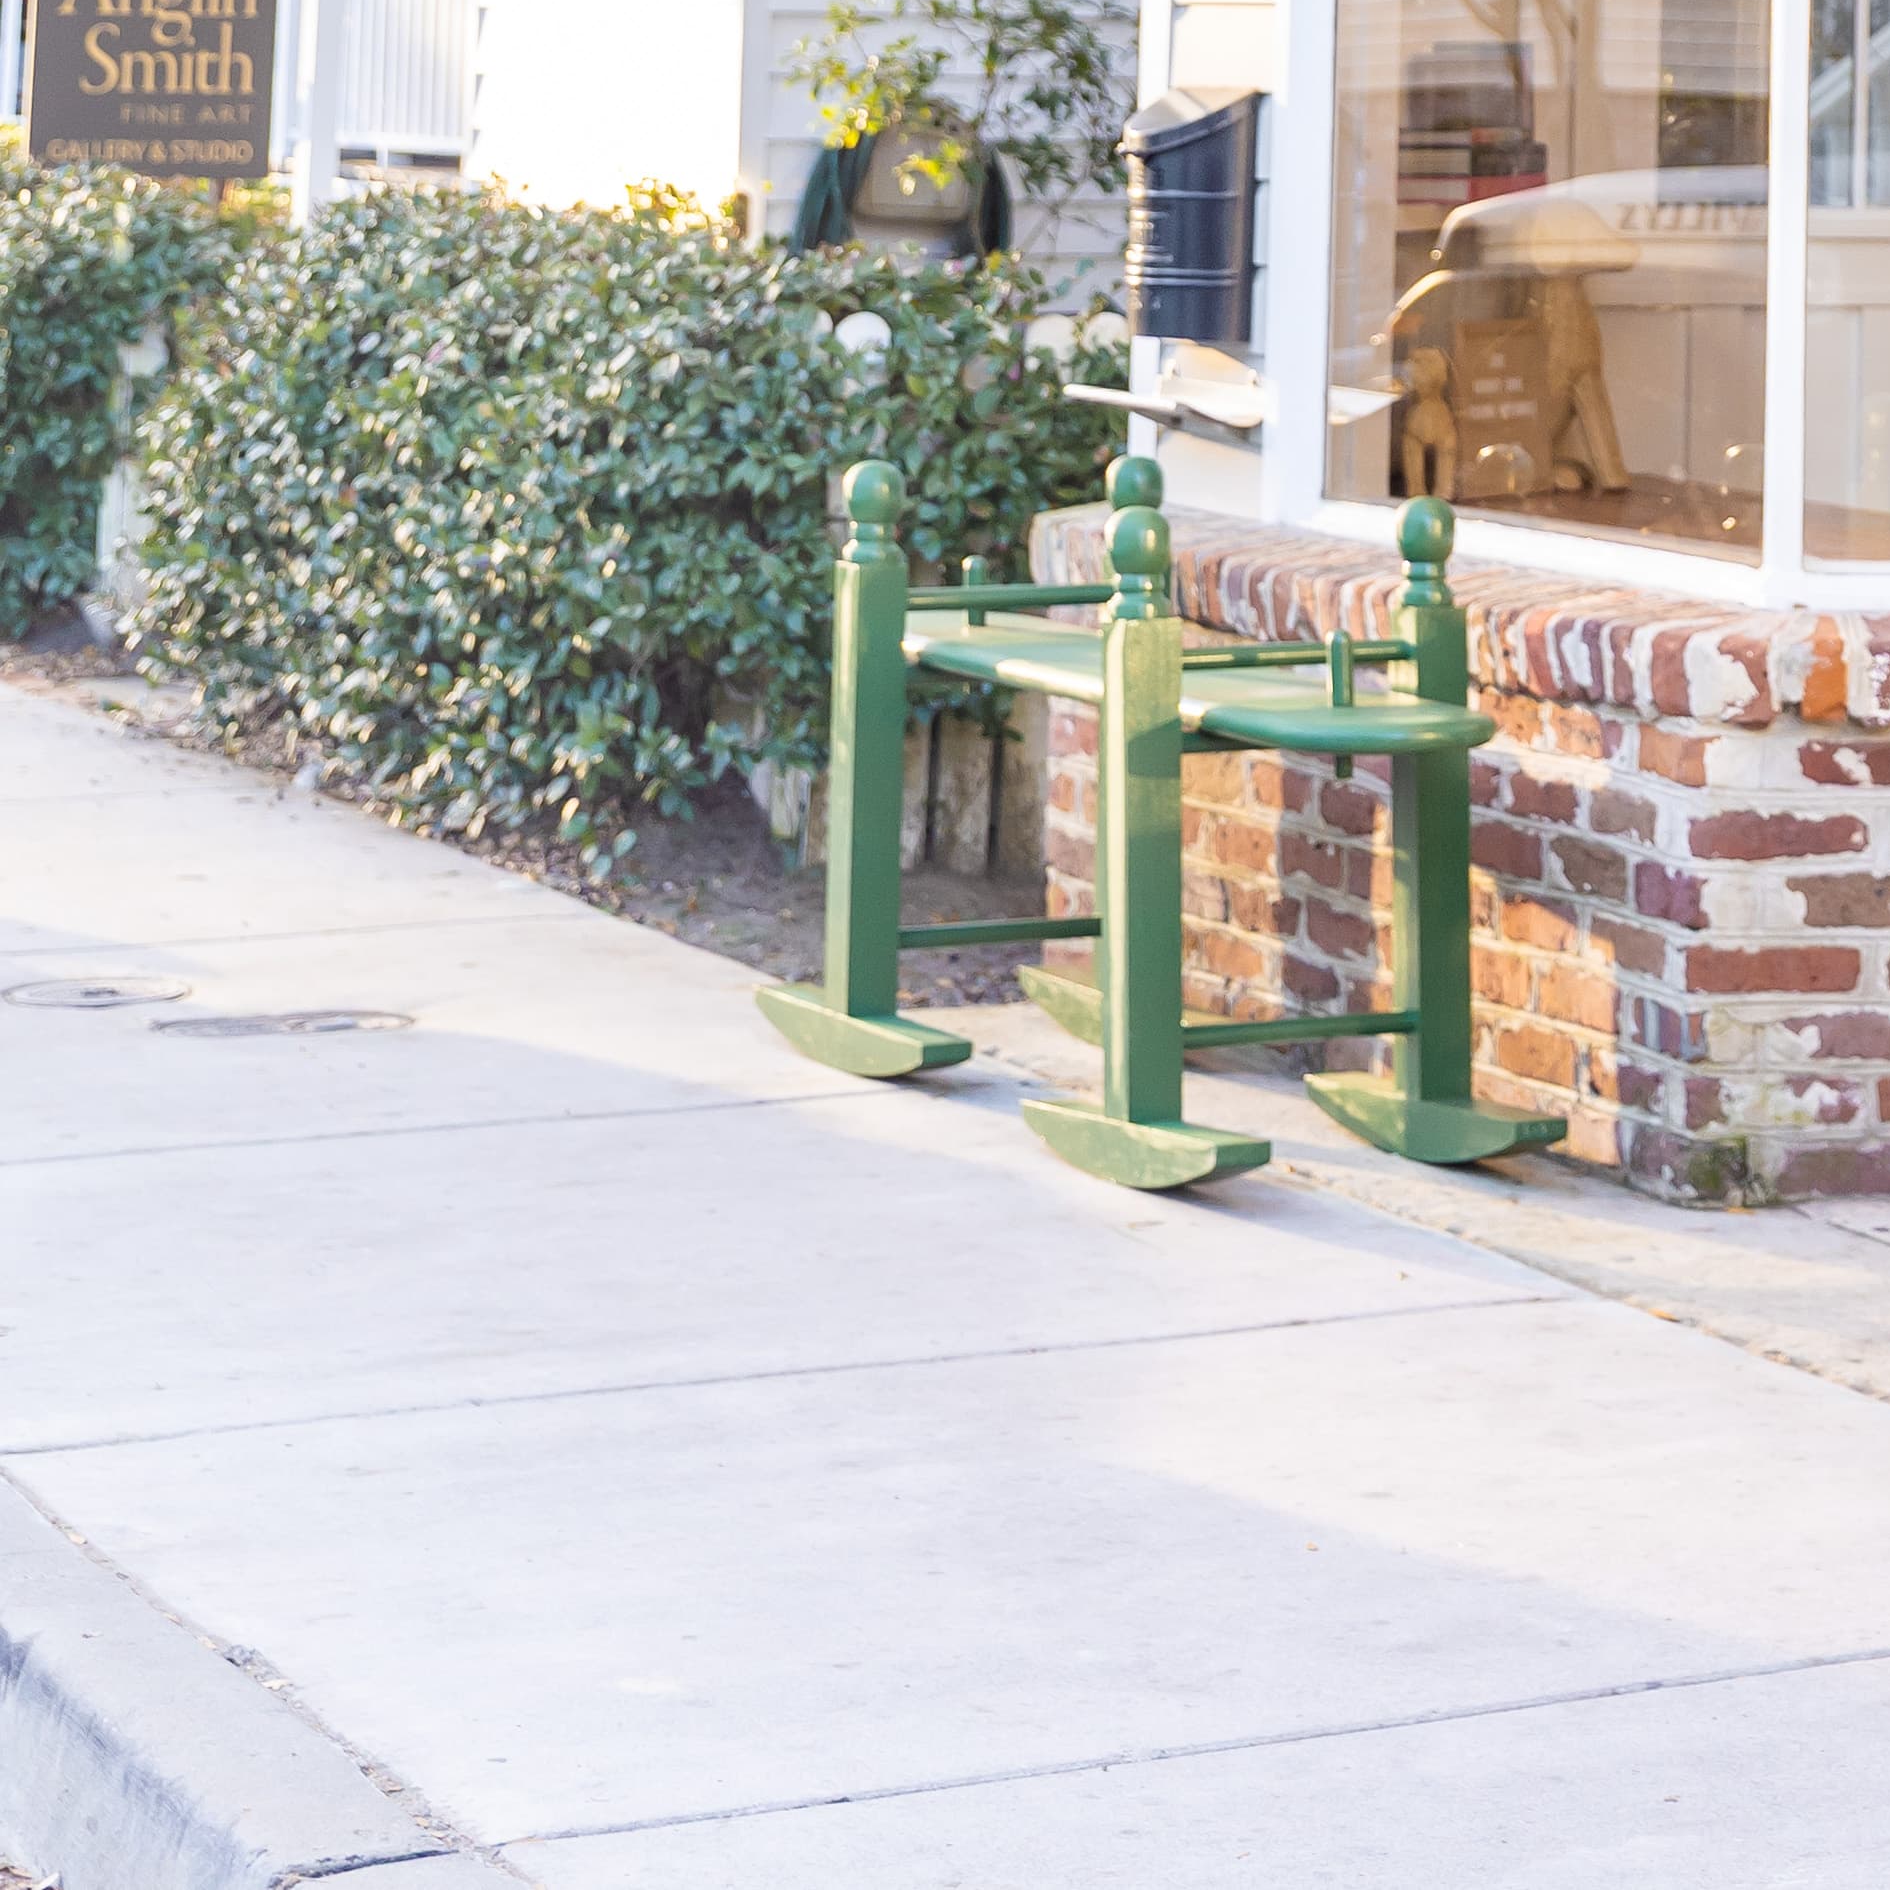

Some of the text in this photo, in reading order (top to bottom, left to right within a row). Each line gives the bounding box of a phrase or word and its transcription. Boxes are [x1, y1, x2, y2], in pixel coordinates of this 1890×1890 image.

[79, 21, 254, 96] Smith
[119, 103, 252, 124] FINE ART
[46, 137, 148, 163] GALLERY
[169, 139, 254, 164] STUDIO
